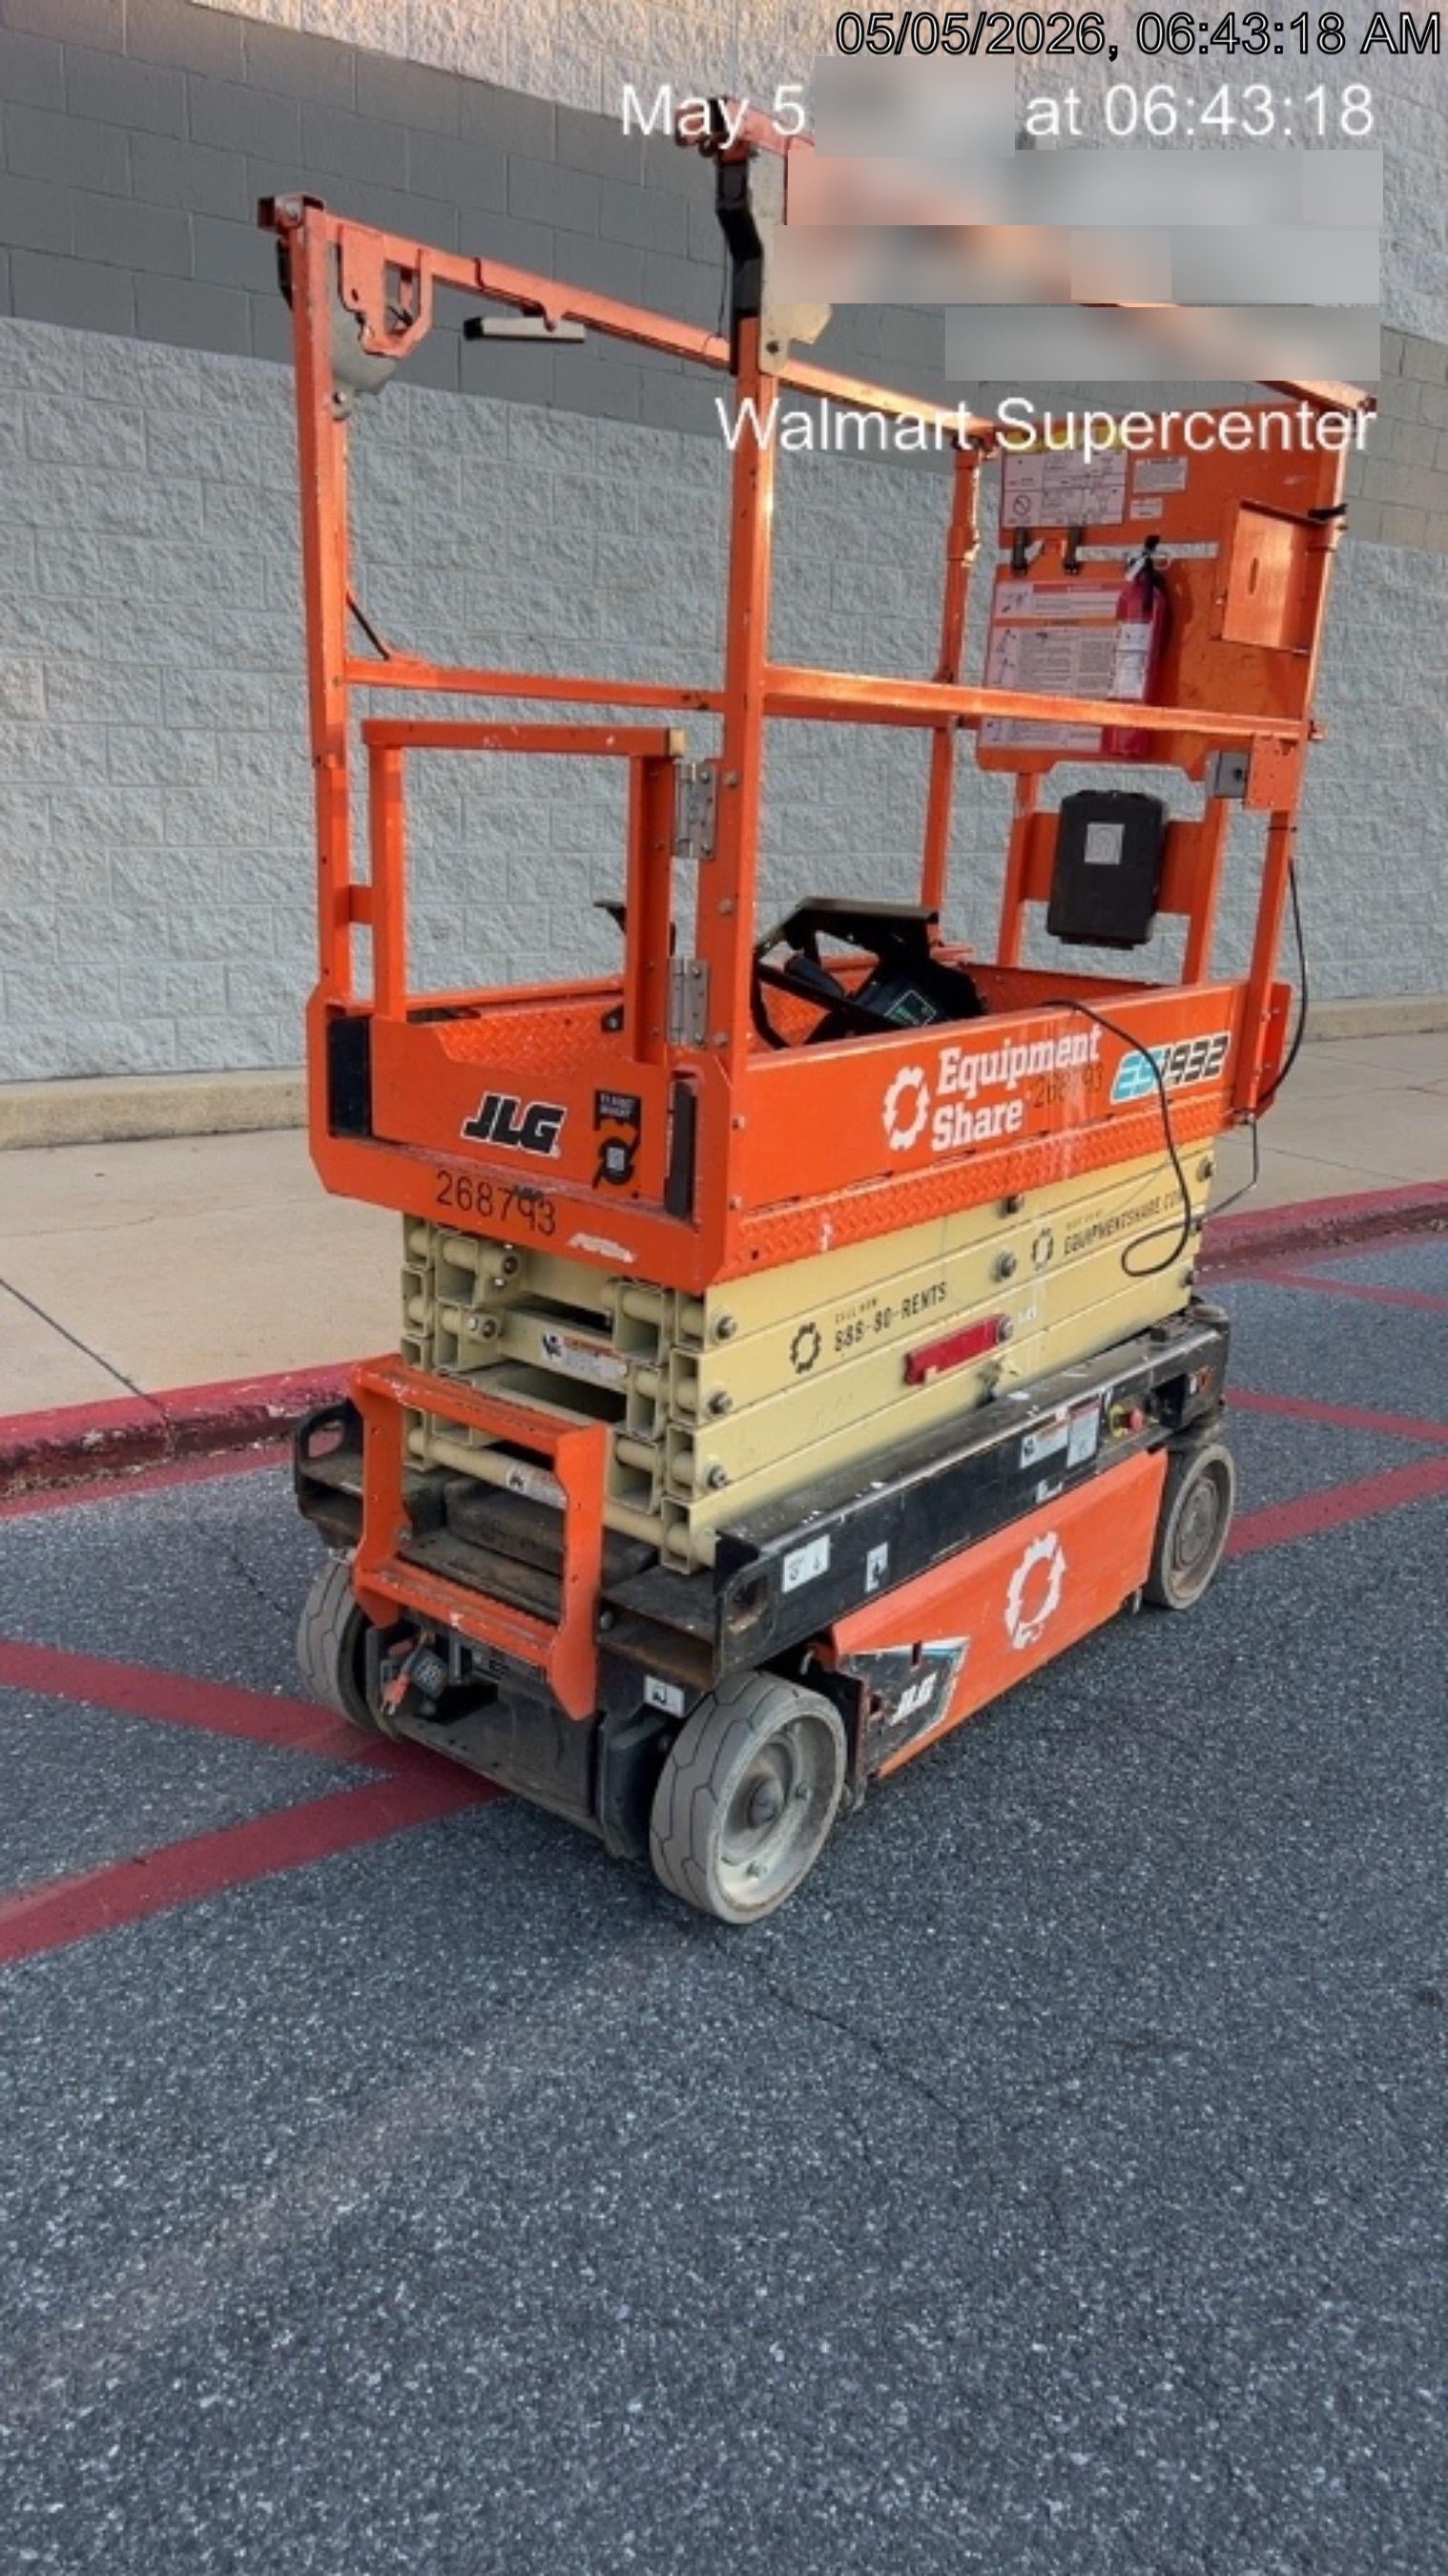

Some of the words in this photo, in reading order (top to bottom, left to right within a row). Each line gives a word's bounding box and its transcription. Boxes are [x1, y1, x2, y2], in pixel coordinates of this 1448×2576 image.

[936, 1022, 1104, 1100] Equipment
[460, 1090, 569, 1158] JLG
[931, 1098, 1024, 1152] Share
[435, 1169, 558, 1237] 268793
